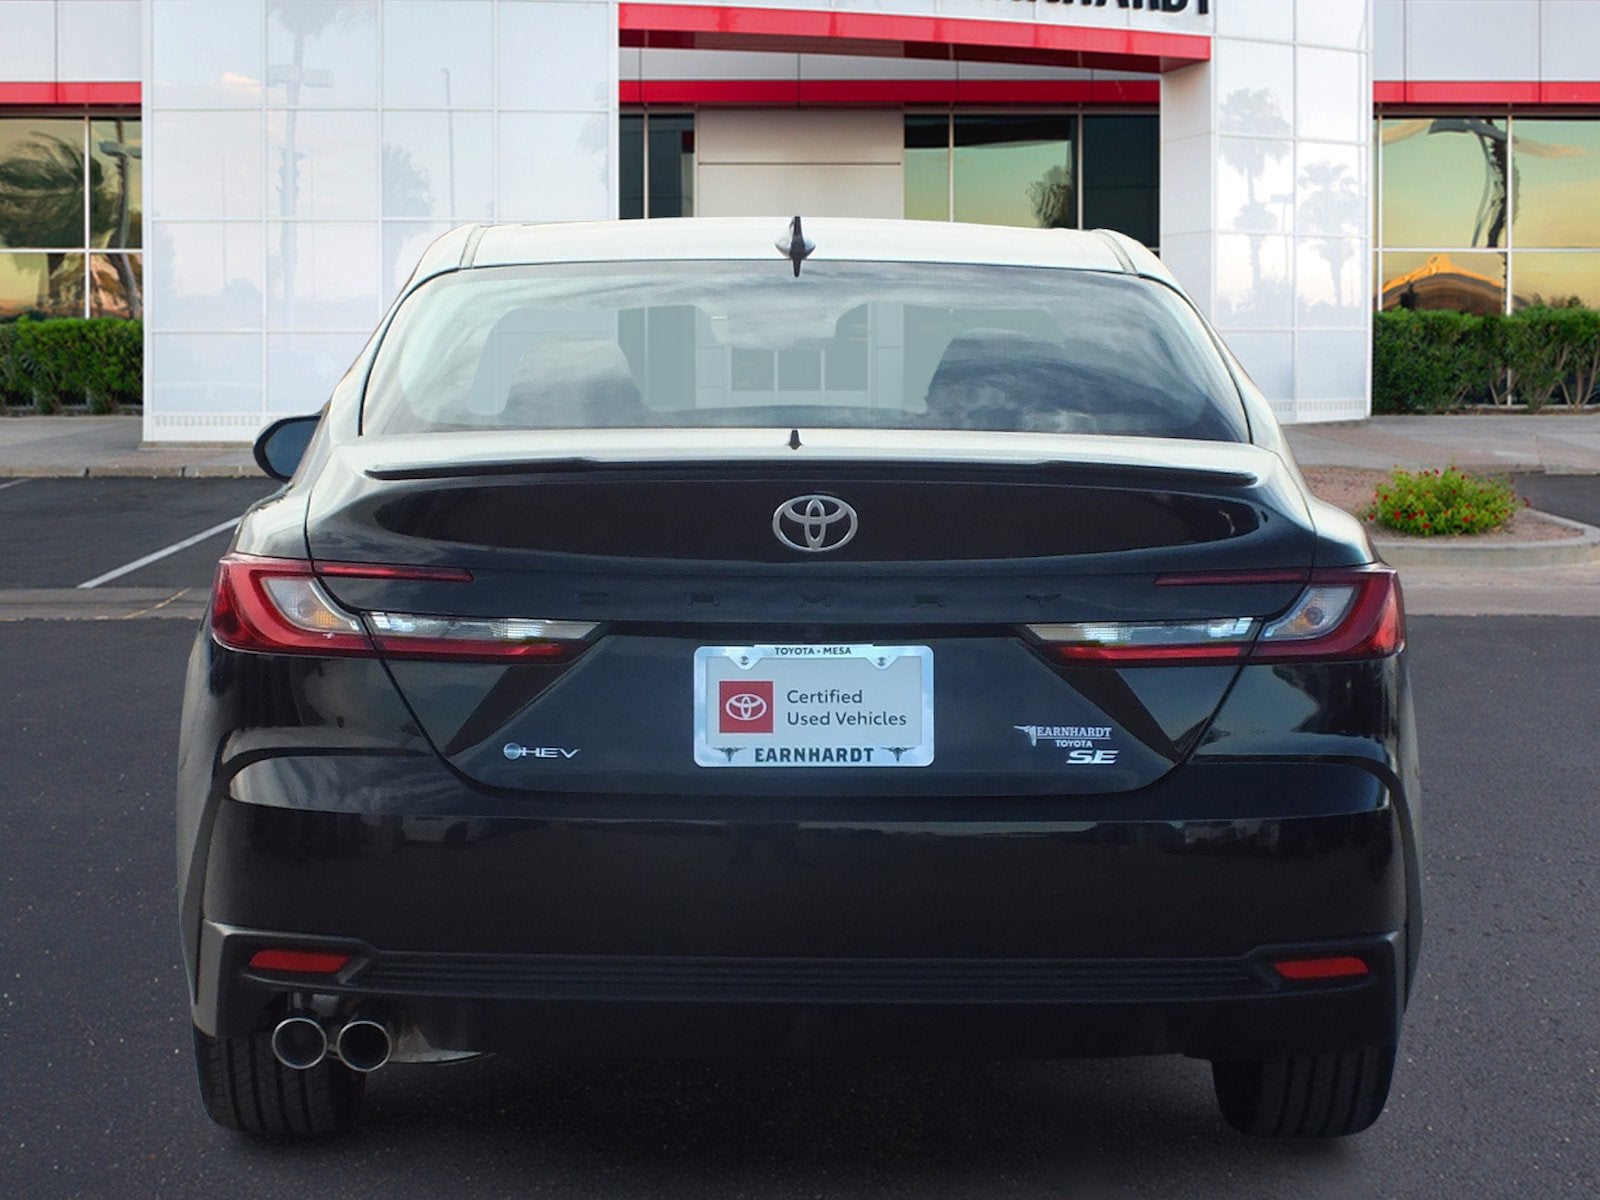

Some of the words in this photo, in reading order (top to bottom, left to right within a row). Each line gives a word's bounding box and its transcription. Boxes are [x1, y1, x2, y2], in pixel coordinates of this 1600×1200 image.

[775, 647, 815, 655] TOYOTA
[823, 647, 852, 655] MESA
[786, 689, 863, 704] Certified
[787, 711, 831, 726] Used
[835, 711, 907, 726] Vehicles
[1036, 726, 1112, 738] EARNHARDT
[1055, 739, 1094, 748] TOYOTA
[754, 747, 875, 763] EARNHARDT
[1065, 749, 1119, 765] SE
